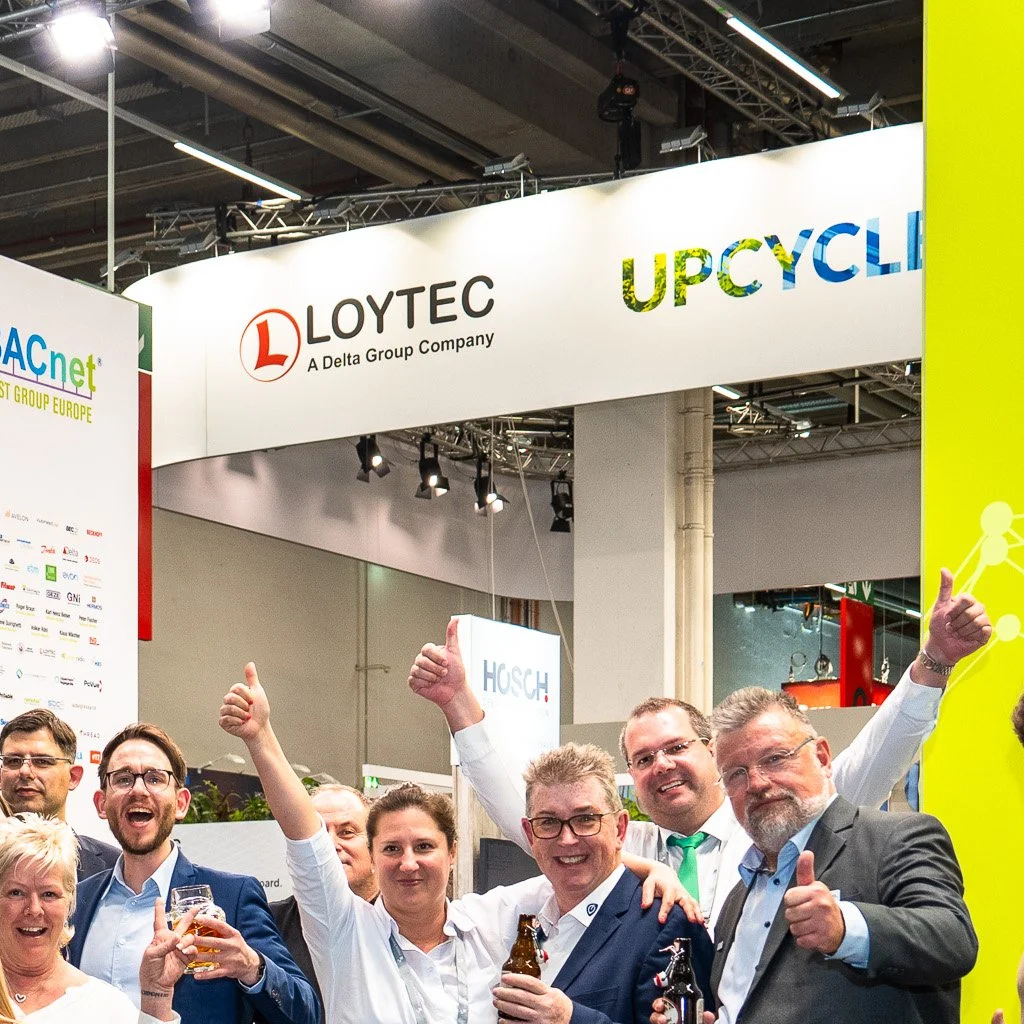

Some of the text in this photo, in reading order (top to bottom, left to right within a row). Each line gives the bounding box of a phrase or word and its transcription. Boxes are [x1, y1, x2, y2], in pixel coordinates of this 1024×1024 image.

[307, 275, 494, 345] LOYTEC
[307, 332, 495, 372] A Delta Group Company
[14, 384, 50, 411] GROUP
[53, 397, 92, 424] EUROPE
[261, 878, 283, 888] oard.
